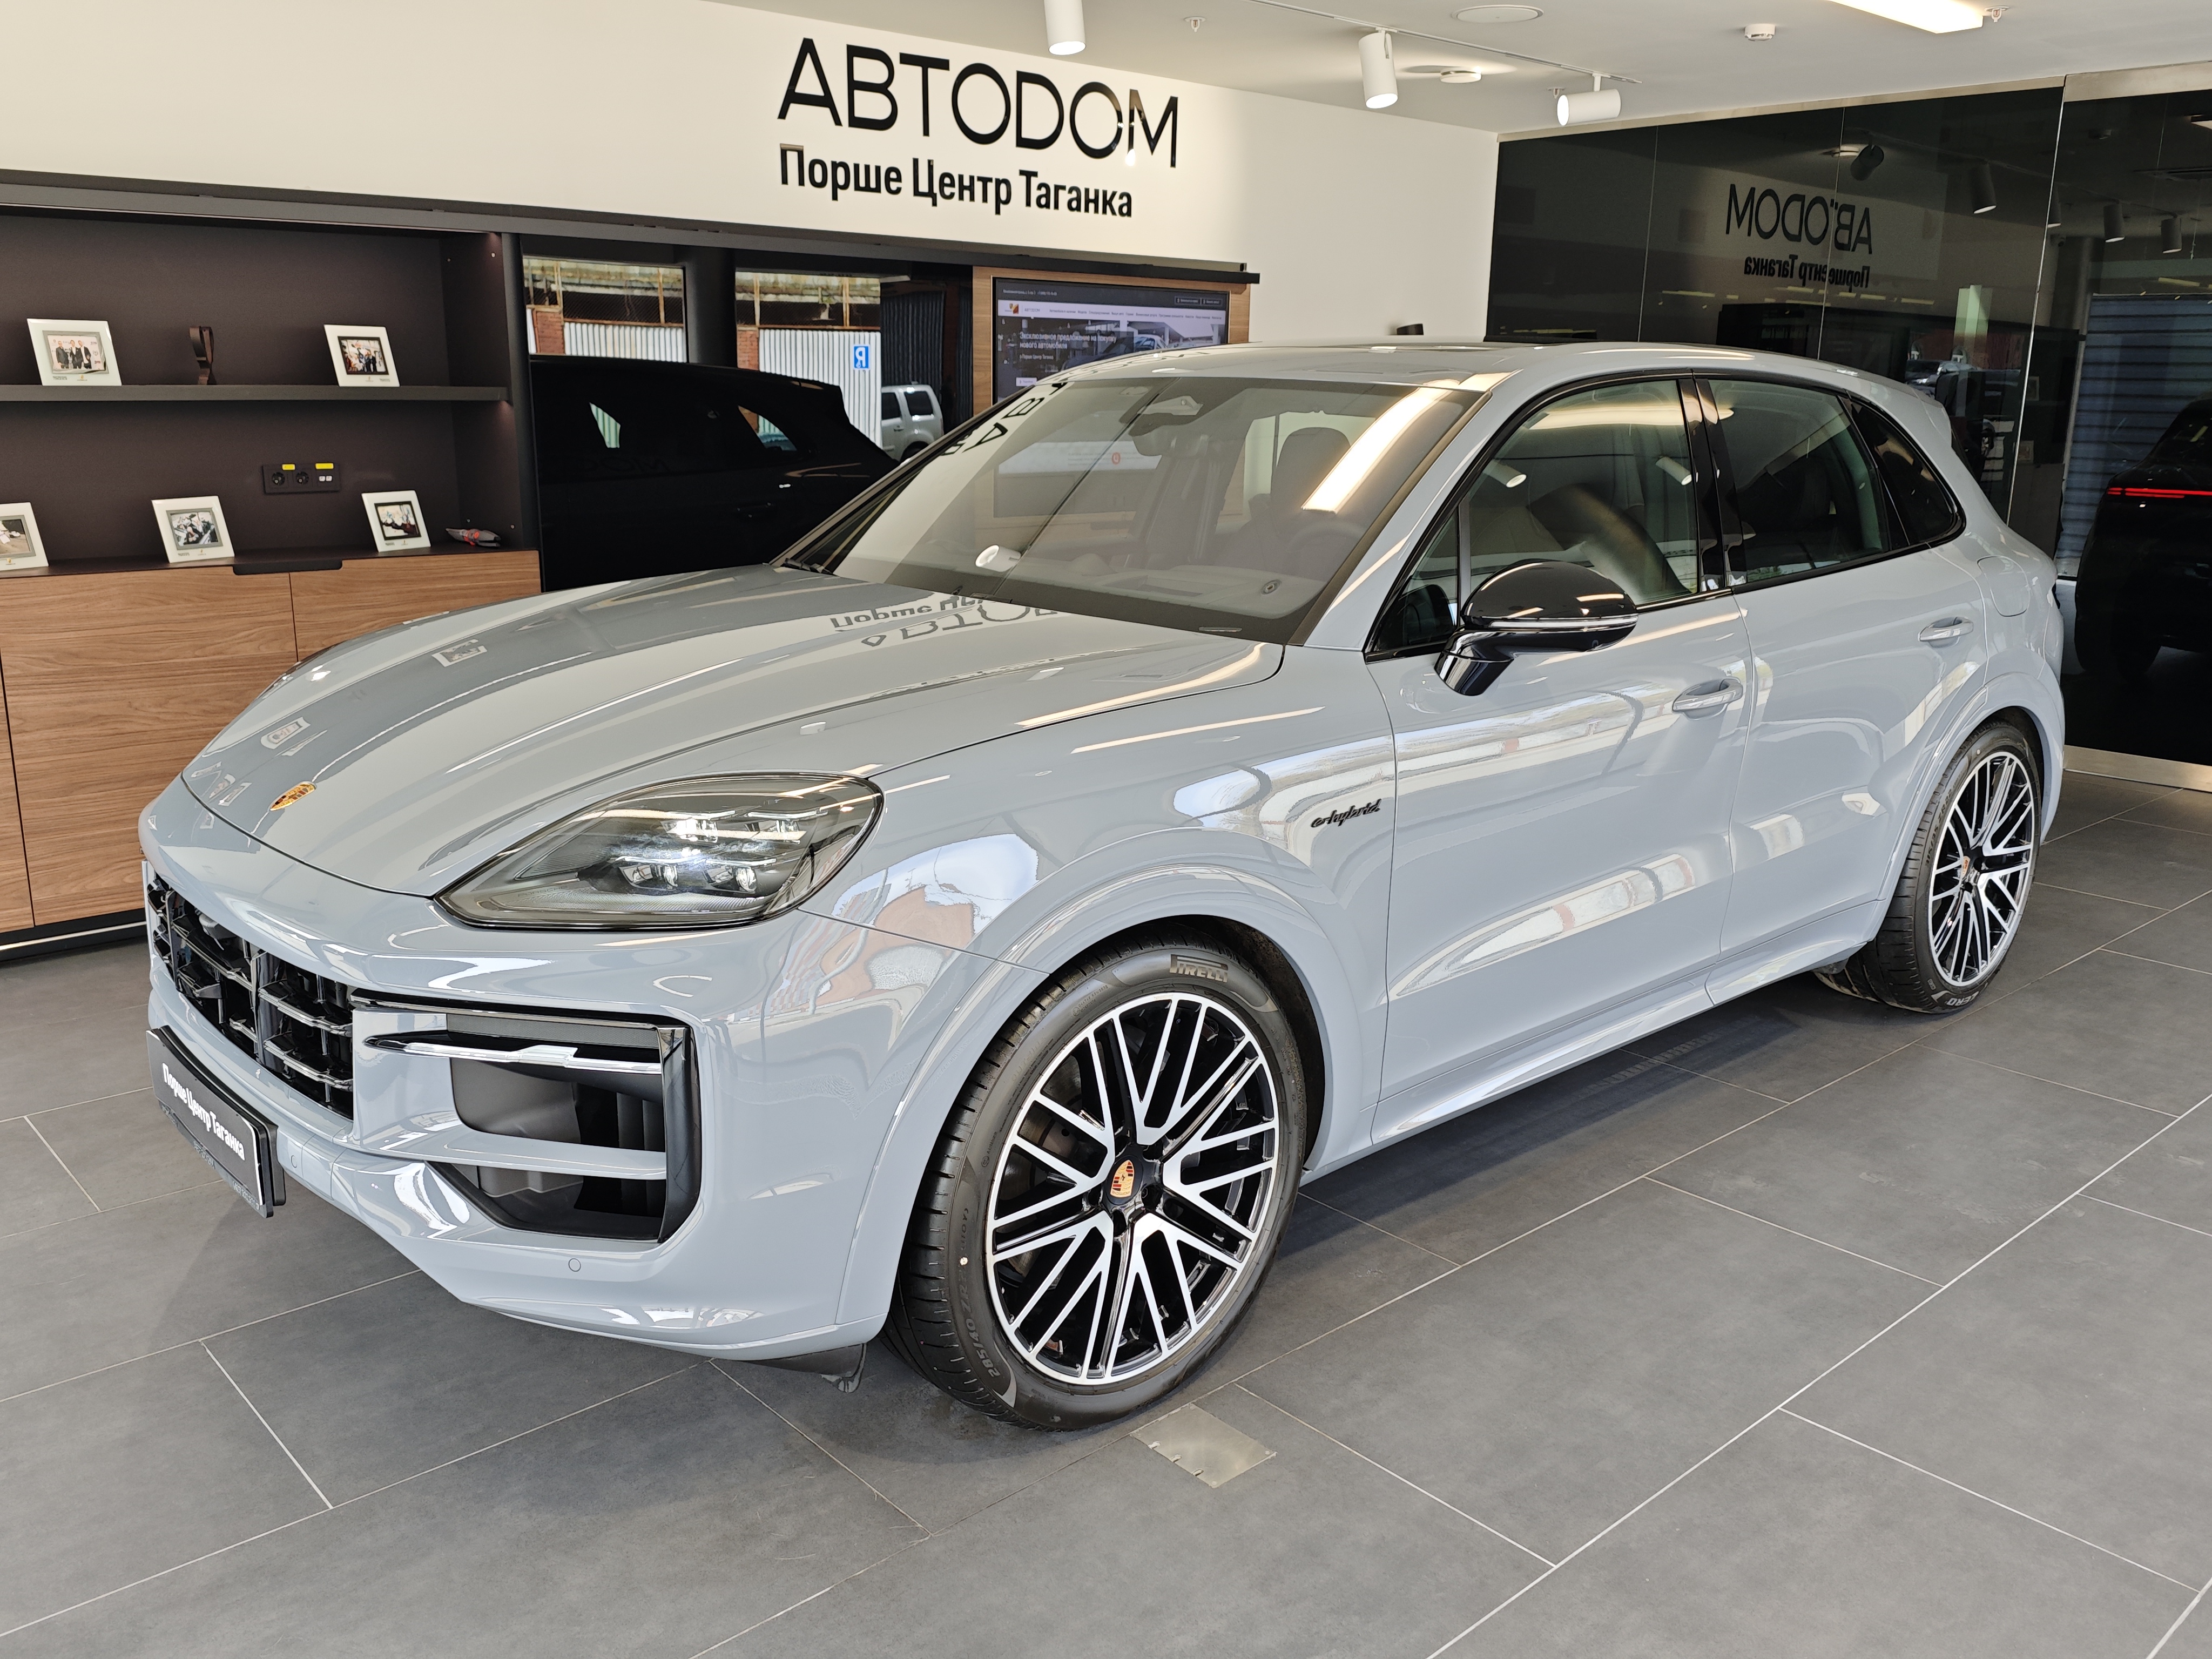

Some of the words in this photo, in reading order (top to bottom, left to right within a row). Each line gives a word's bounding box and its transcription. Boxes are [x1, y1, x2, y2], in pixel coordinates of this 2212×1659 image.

[779, 144, 902, 200] Порше
[912, 158, 1012, 215] Центр
[1019, 169, 1133, 217] Таганка
[1169, 954, 1229, 983] PIRELLI
[1946, 991, 1979, 1006] ZERO
[162, 1062, 187, 1104] Порше
[186, 1087, 211, 1132] Центр
[210, 1110, 245, 1161] Таганка
[966, 1318, 1001, 1377] 285/40
